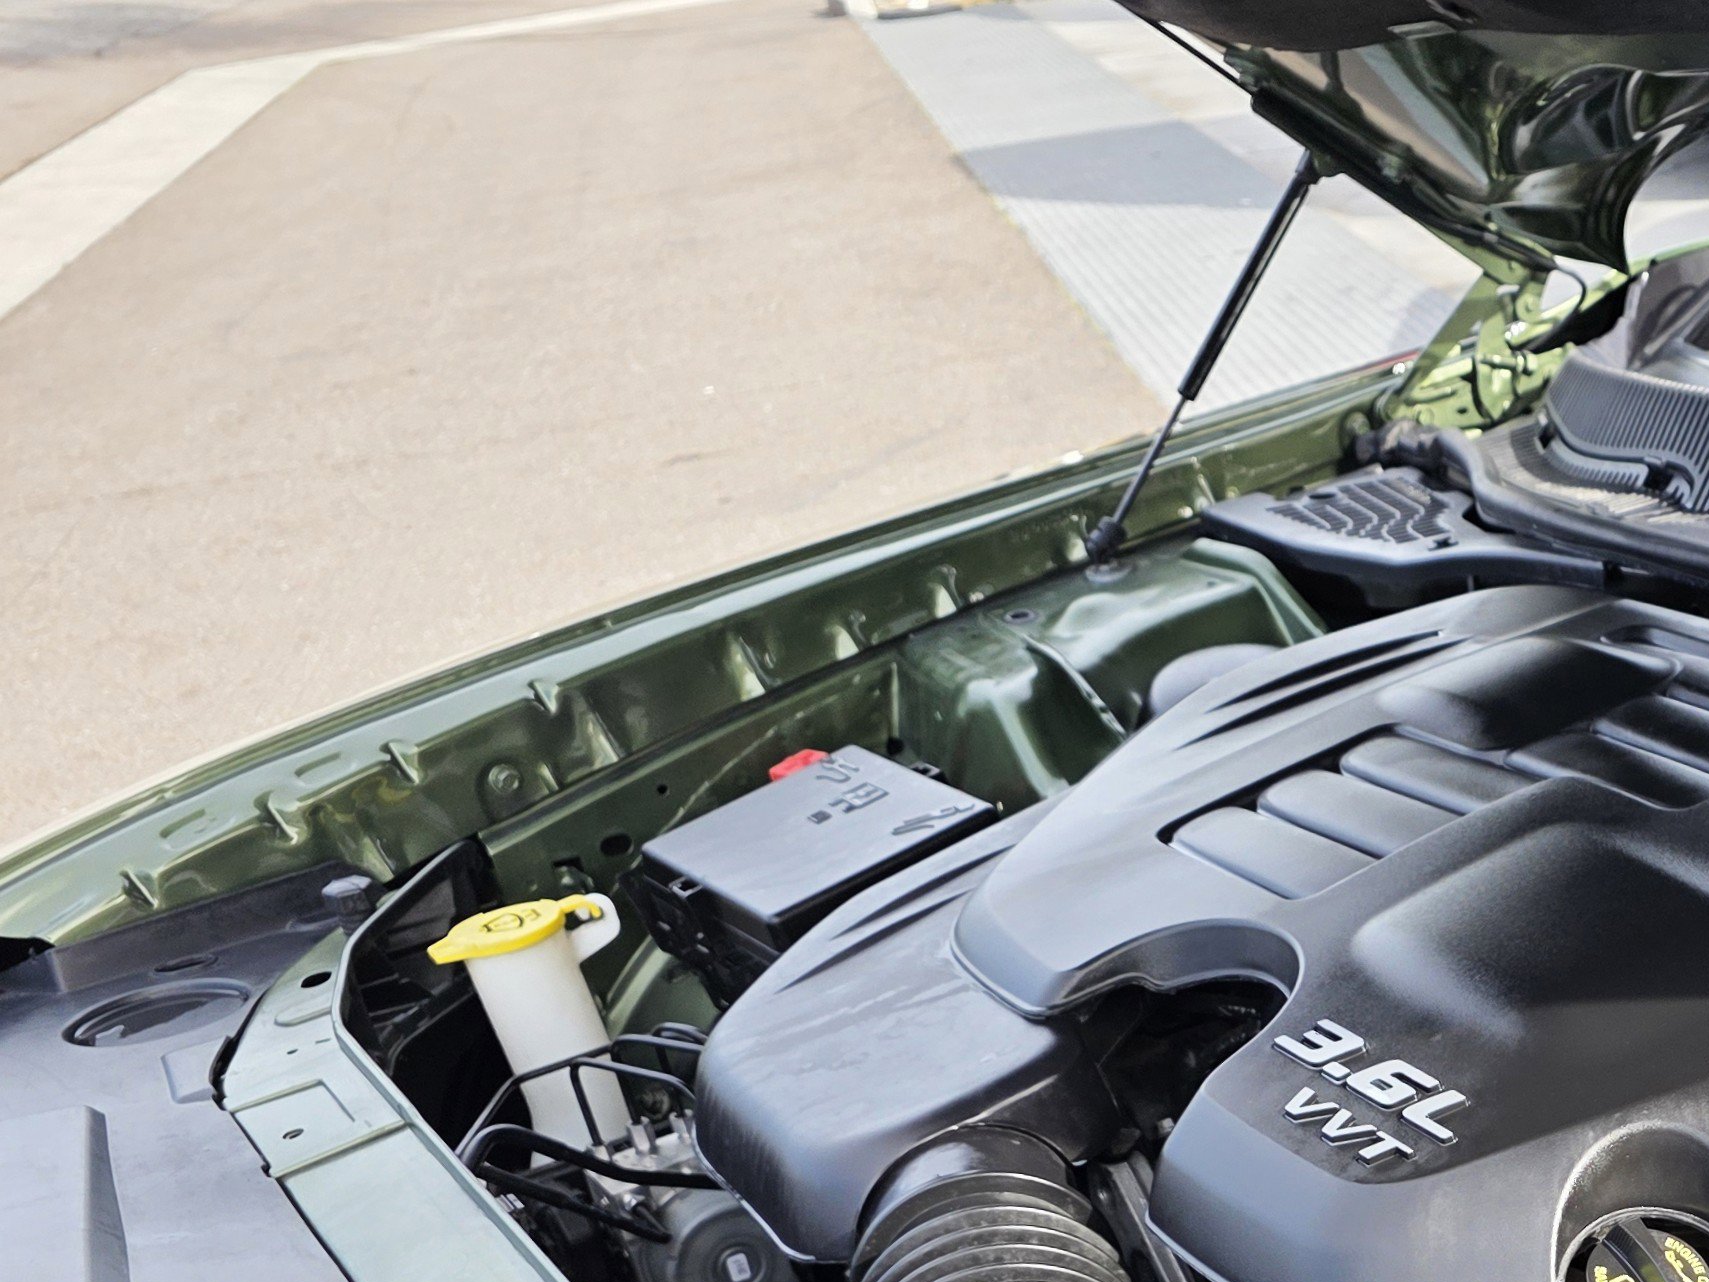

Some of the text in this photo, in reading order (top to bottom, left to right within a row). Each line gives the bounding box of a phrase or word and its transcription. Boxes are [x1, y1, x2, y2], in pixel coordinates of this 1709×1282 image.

[1272, 1018, 1471, 1146] 3.6L
[1284, 1086, 1417, 1167] VVT
[1665, 1237, 1706, 1275] ENGINE
